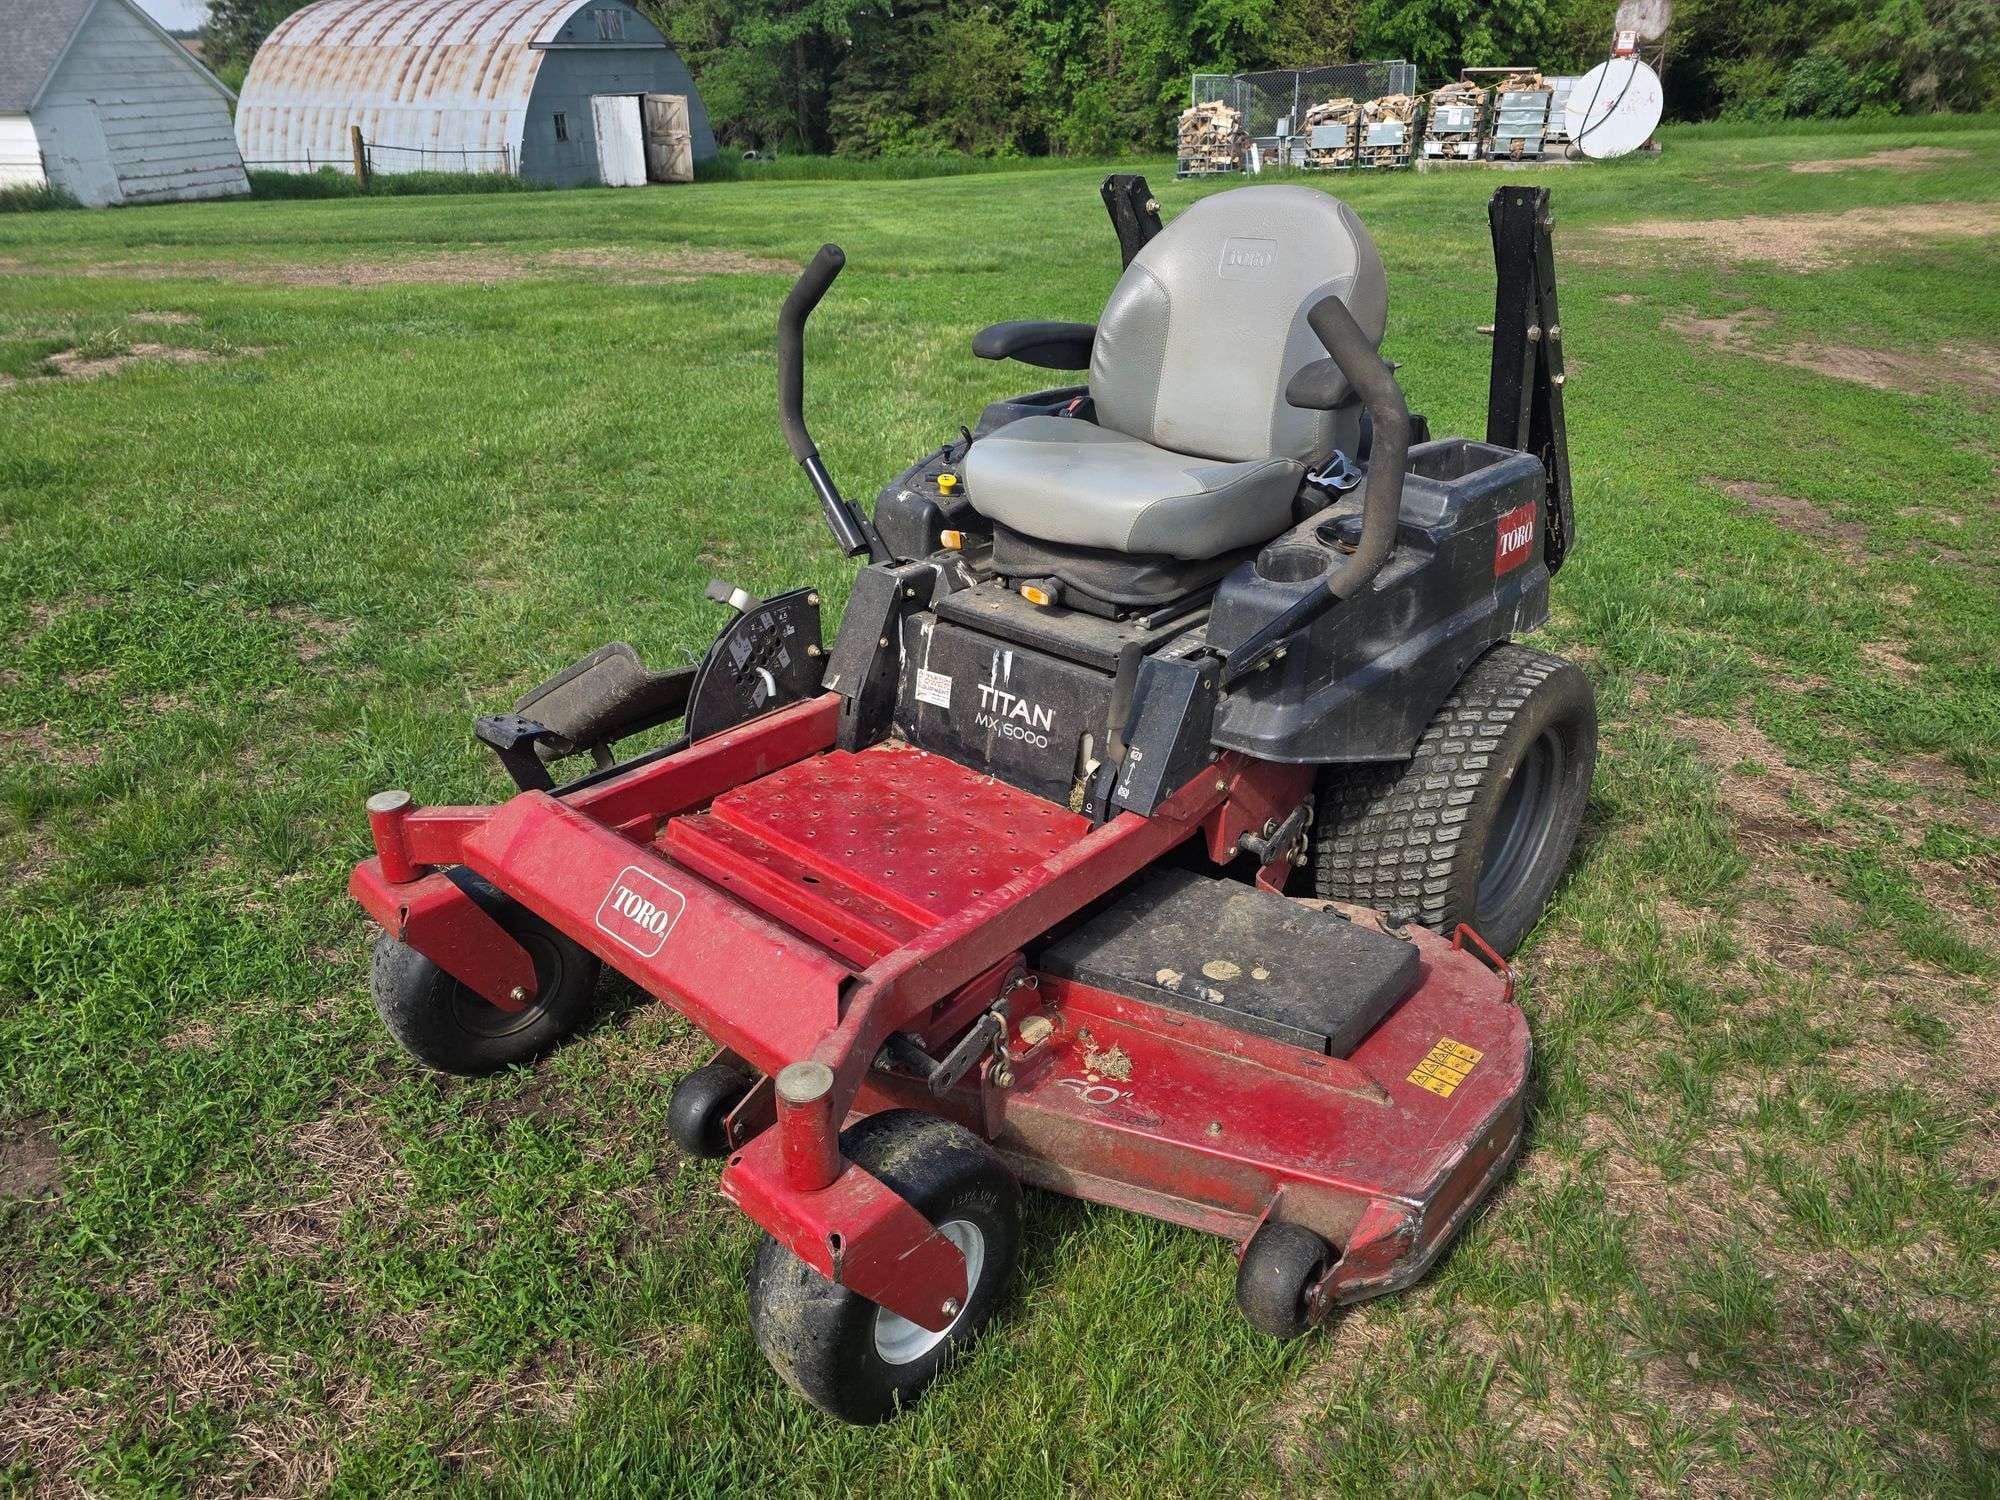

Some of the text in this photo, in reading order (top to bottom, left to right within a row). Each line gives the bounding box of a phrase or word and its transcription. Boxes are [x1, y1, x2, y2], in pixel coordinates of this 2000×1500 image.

[1500, 521, 1533, 557] TORO
[978, 684, 1053, 731] TITAN
[611, 885, 668, 935] TORO
